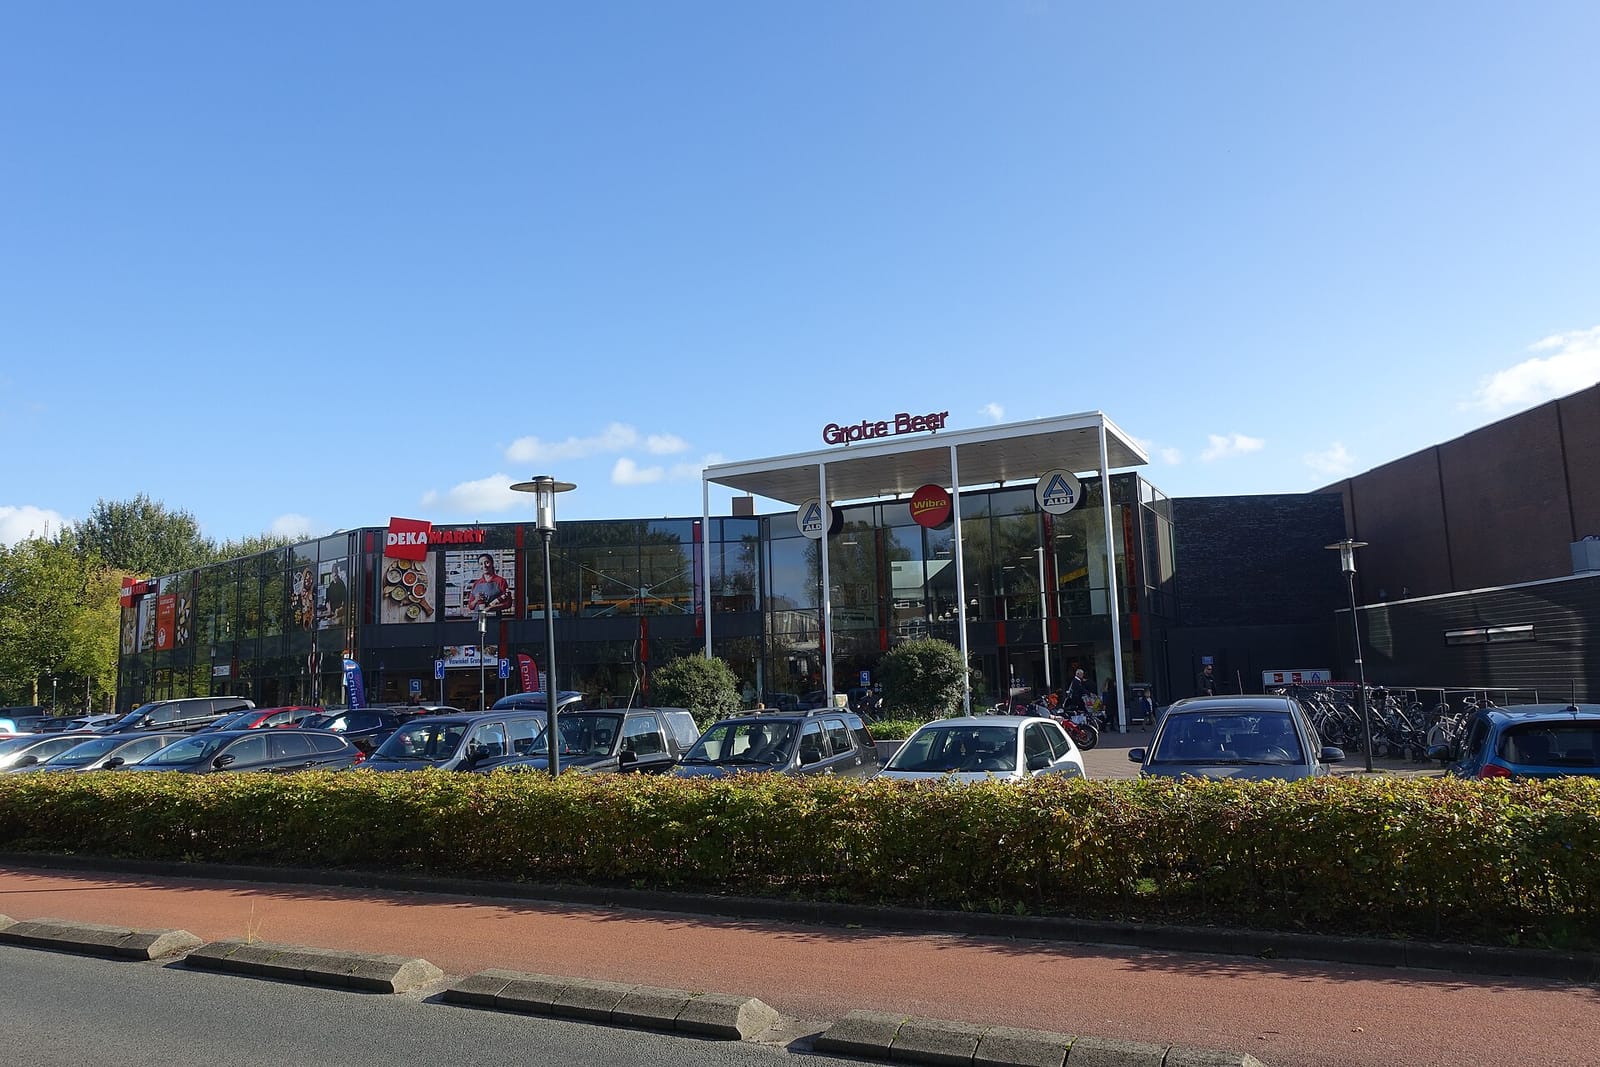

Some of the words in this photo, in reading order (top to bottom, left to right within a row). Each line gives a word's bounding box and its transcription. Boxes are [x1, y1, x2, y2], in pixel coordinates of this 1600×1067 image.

[823, 420, 888, 444] Grote
[894, 412, 949, 434] Beer
[914, 499, 946, 509] Wibra
[1046, 497, 1070, 506] ALDI
